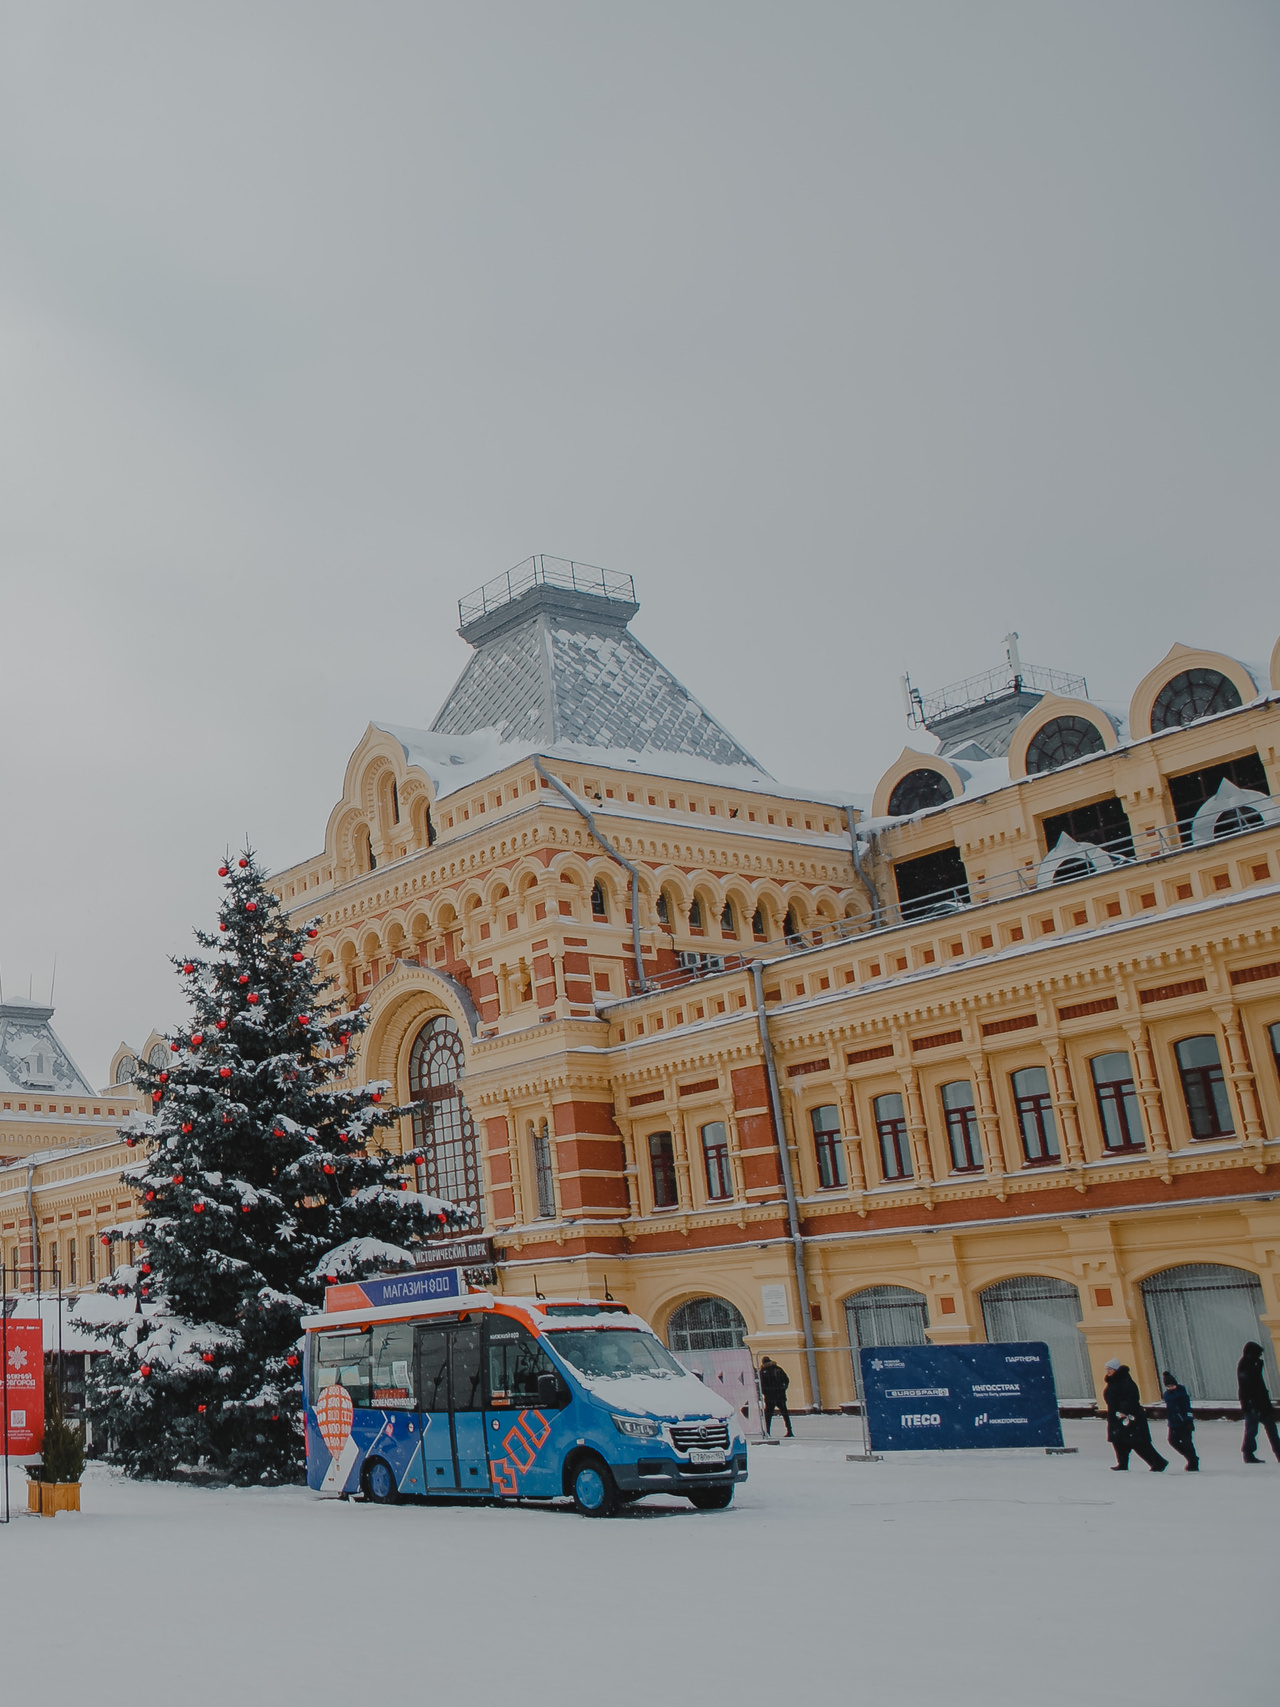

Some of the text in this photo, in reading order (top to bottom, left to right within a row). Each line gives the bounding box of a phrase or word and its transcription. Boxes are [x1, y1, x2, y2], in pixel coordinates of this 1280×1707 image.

[415, 1243, 487, 1263] ИСТОРИЧЕСКИЙ ПАРК
[901, 1414, 941, 1426] ITECO
